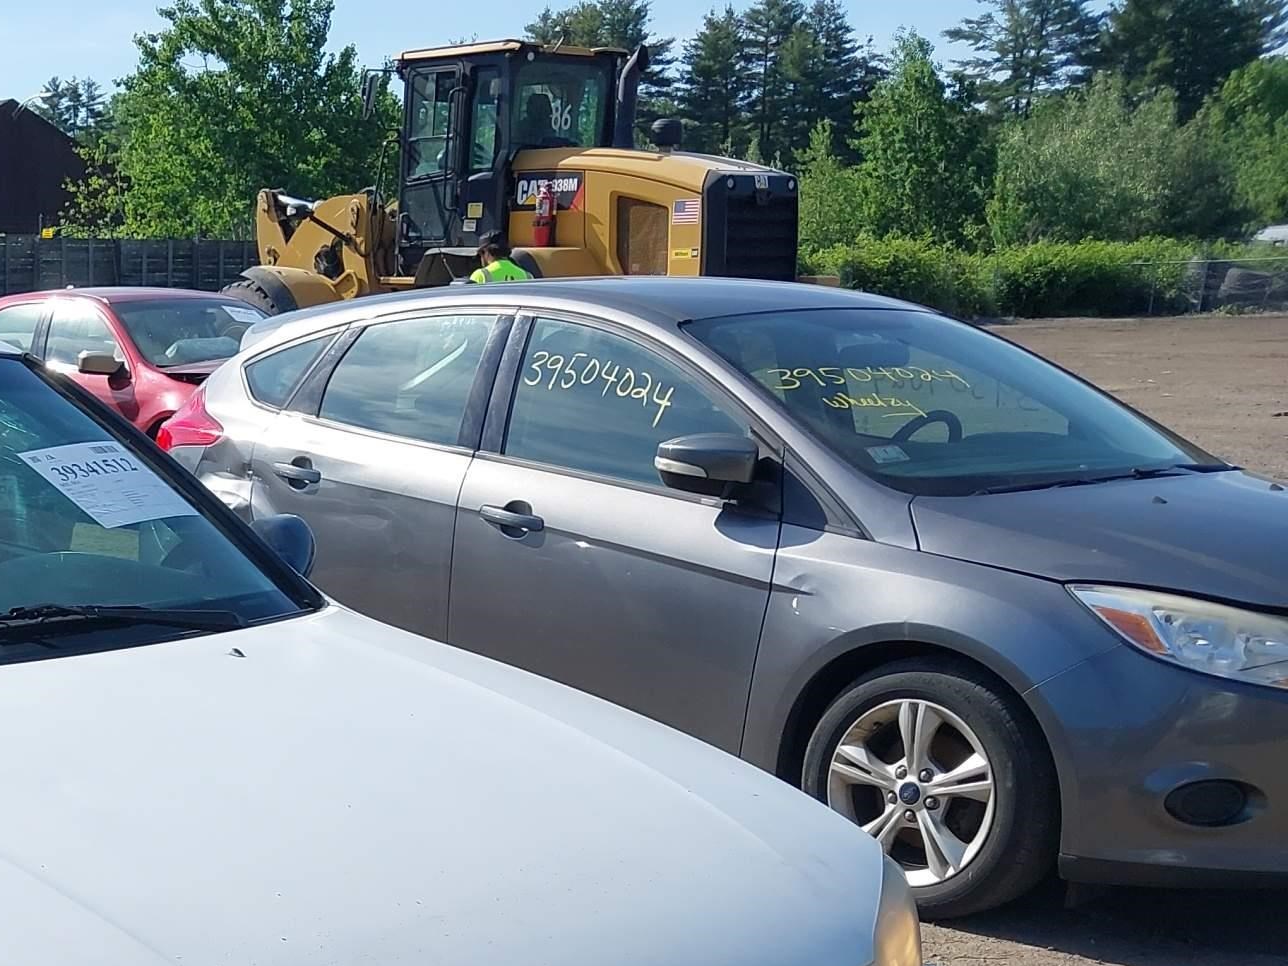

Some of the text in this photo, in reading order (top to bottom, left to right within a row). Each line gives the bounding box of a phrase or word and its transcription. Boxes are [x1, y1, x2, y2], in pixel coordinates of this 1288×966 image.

[552, 178, 578, 192] 938M
[524, 351, 675, 429] 39504024
[767, 366, 971, 390] 39504024
[51, 457, 138, 482] 39341512
